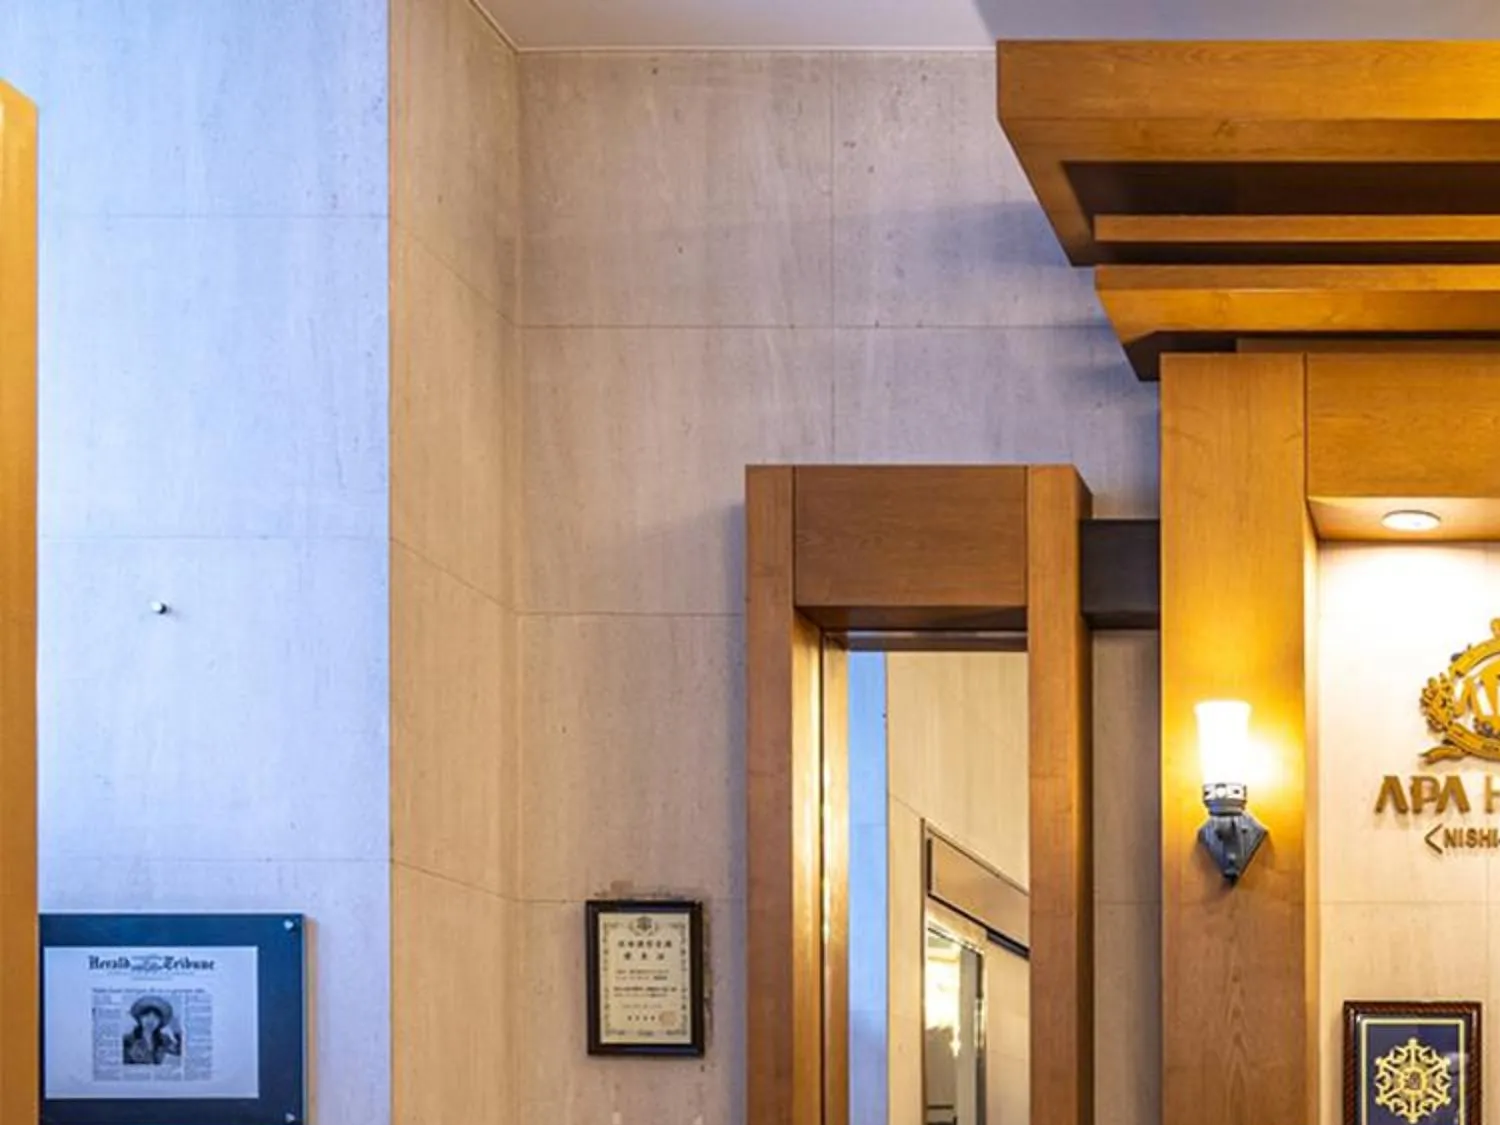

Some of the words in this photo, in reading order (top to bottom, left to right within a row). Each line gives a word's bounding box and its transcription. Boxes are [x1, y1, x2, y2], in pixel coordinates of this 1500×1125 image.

[1375, 775, 1471, 815] APA
[88, 955, 131, 970] Herald
[163, 955, 215, 970] Tribune
